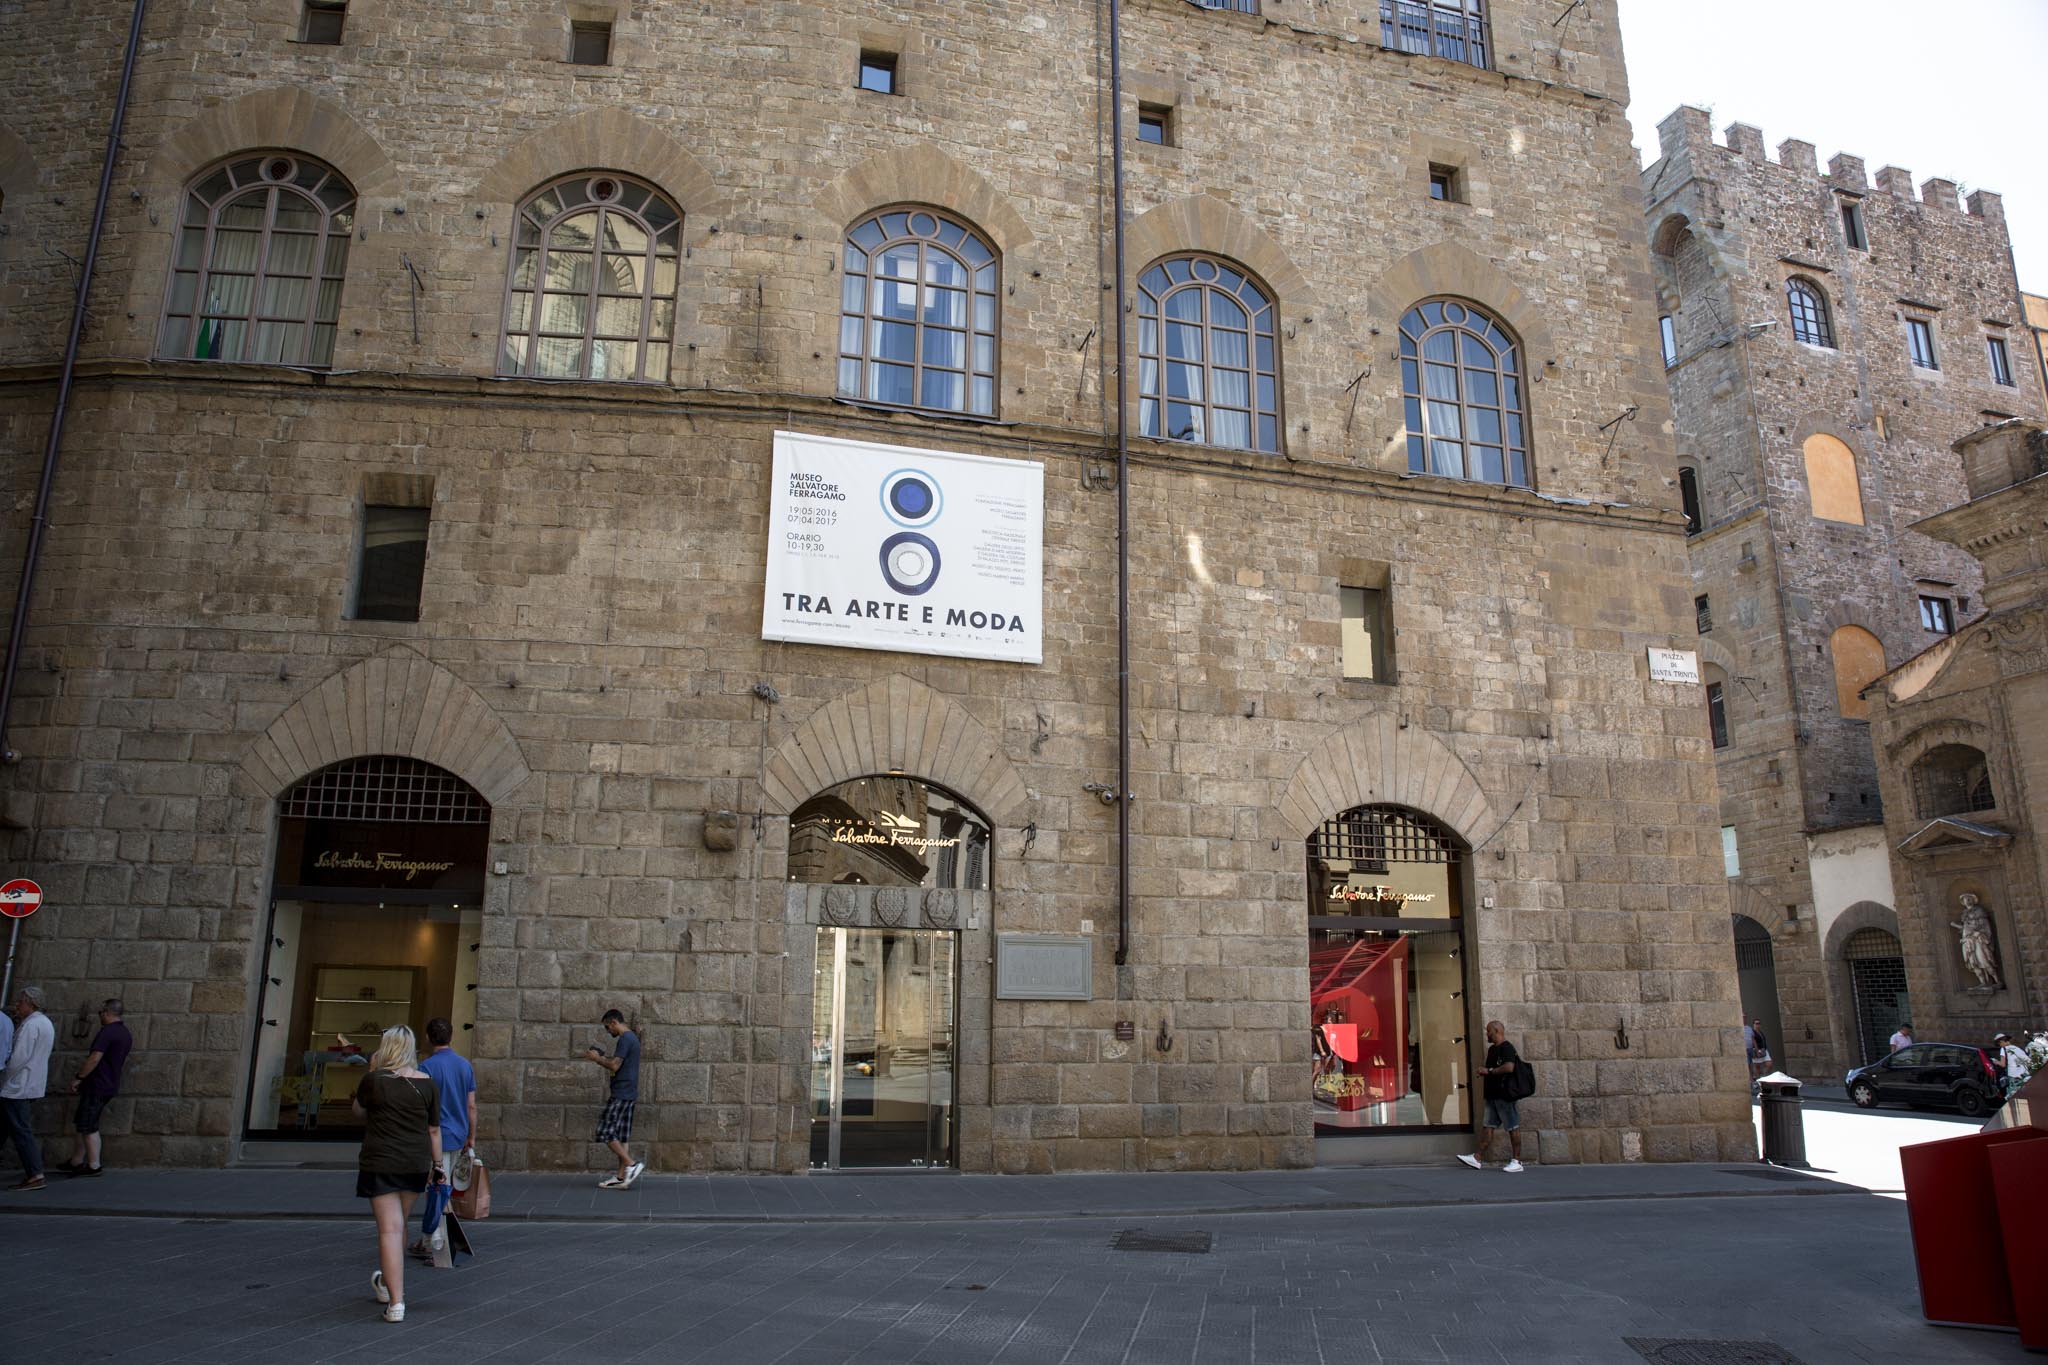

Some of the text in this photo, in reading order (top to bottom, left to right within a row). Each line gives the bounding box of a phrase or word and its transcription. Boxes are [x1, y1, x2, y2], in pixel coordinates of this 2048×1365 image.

[790, 472, 822, 483] MUSEO
[790, 481, 839, 492] SALVATORE
[789, 488, 846, 501] FERRAGAMO
[786, 532, 821, 542] ORARIO
[782, 592, 832, 615] TRA
[845, 599, 909, 622] ARTE
[922, 606, 933, 624] E
[946, 608, 1025, 633] MODA
[1661, 653, 1684, 661] PIAZZA
[1652, 669, 1697, 679] SANTA TRINITA
[821, 818, 876, 826] MUSEO
[832, 827, 961, 856] Salvatore Ferragamo
[313, 850, 455, 881] Salvatore Ferragamo
[1329, 884, 1436, 910] Salvatore Ferragamo
